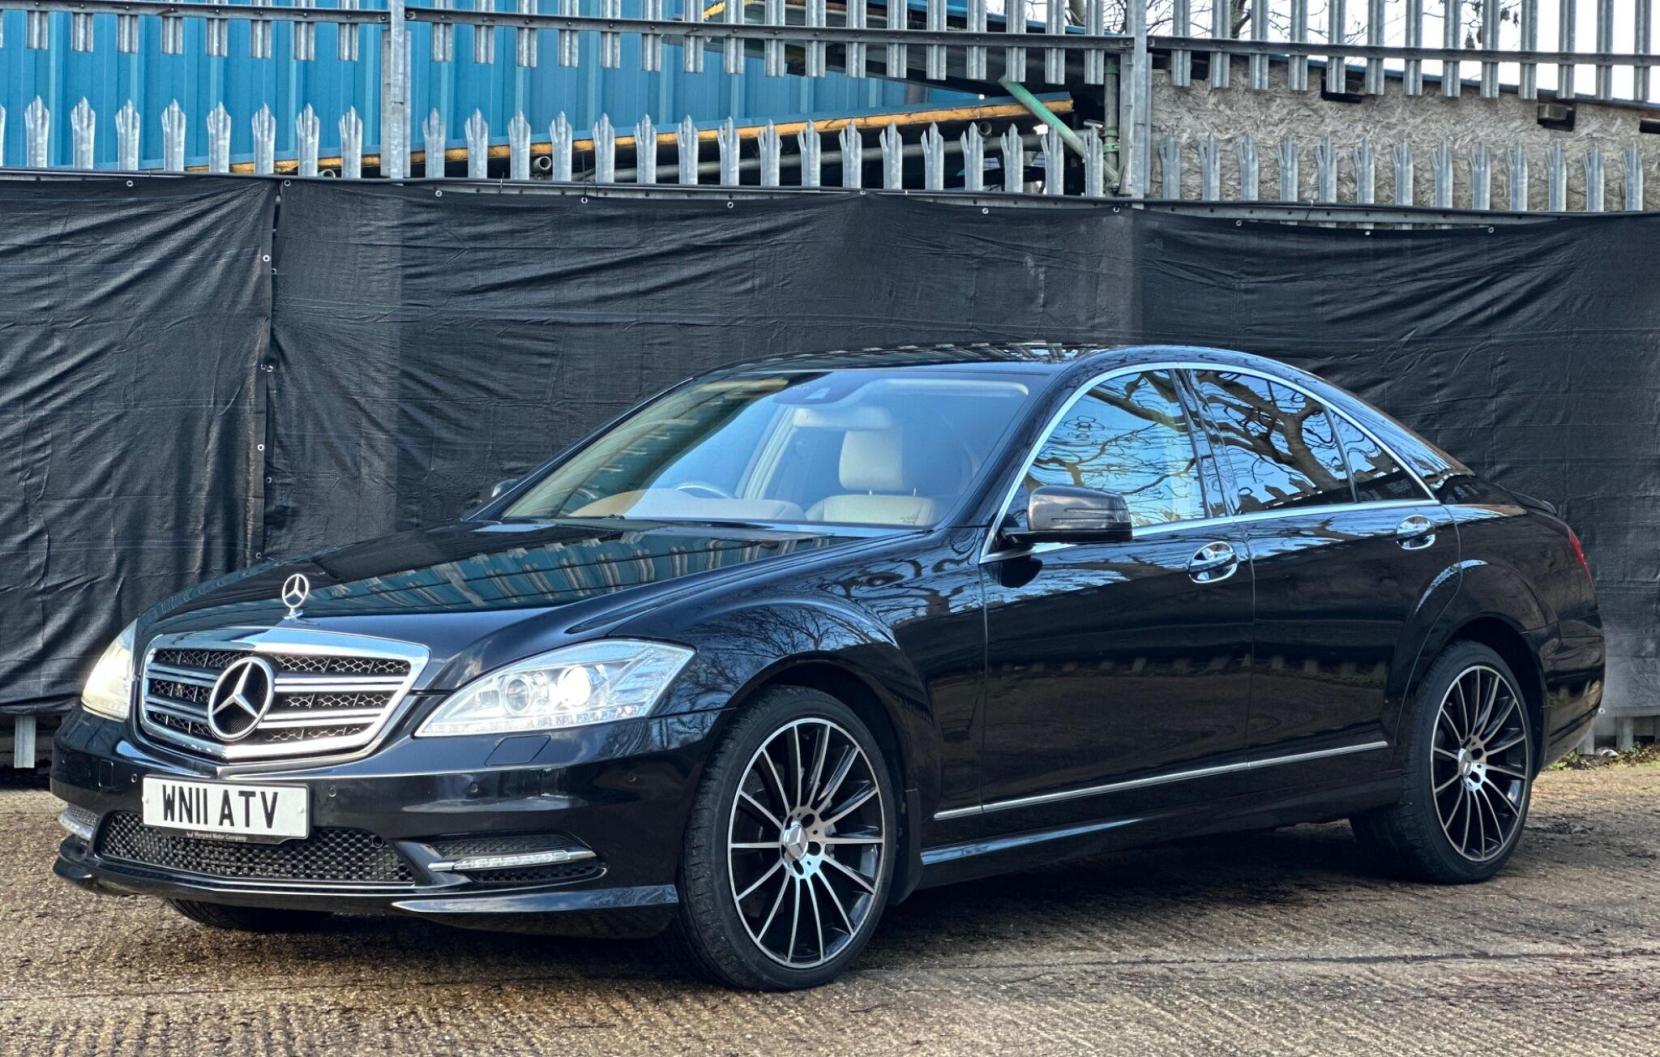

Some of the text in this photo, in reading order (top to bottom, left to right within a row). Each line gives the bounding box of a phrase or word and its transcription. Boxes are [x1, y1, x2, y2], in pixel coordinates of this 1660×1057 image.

[162, 784, 279, 829] WN11 ATV
[226, 834, 248, 843] Company
